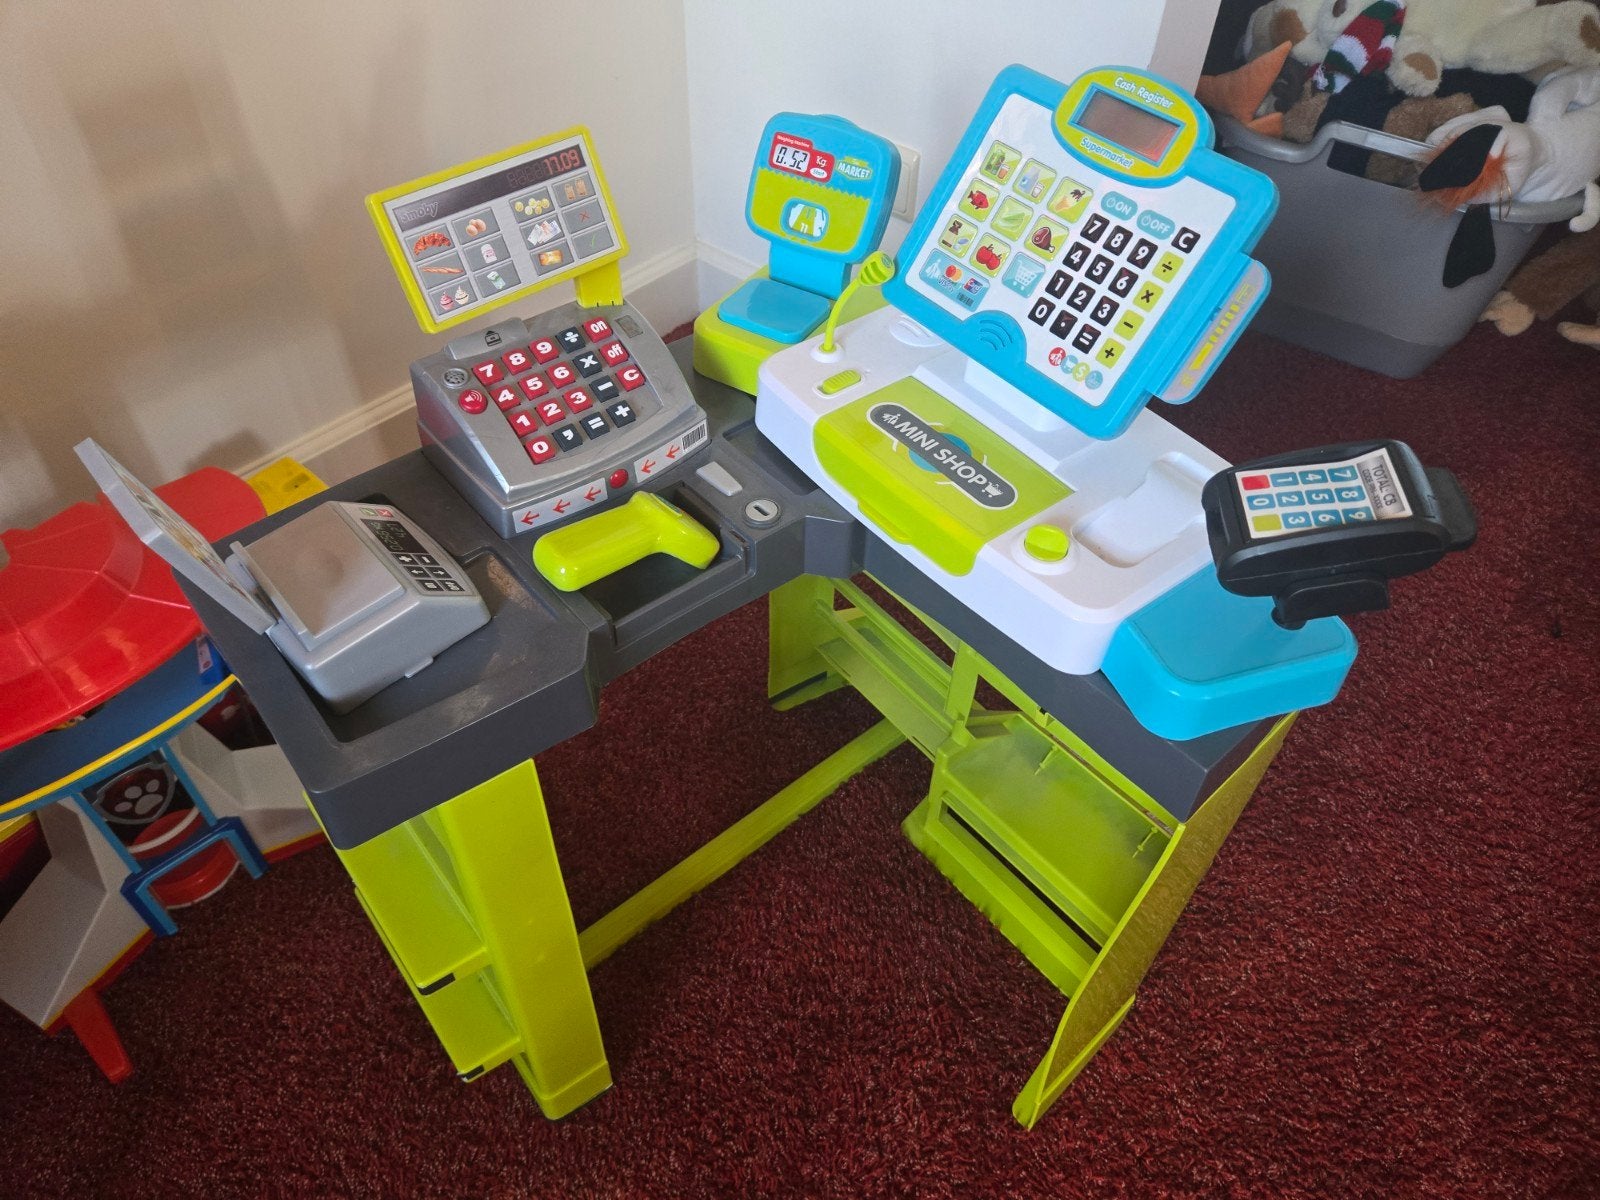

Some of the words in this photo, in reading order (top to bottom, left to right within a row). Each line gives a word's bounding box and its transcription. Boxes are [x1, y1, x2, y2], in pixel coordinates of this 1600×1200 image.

[1114, 77, 1136, 93] Cash
[1137, 87, 1174, 108] Register
[776, 147, 807, 169] 0.52
[1080, 137, 1133, 169] Supermarket
[544, 149, 581, 175] 17.09
[816, 156, 827, 167] Kg
[838, 162, 871, 178] MARKET
[400, 200, 439, 224] smoby
[1114, 201, 1132, 215] ON
[1087, 220, 1102, 234] 7
[1151, 218, 1171, 234] OFF
[1110, 233, 1124, 248] 8
[1178, 233, 1194, 248] C
[1070, 250, 1083, 264] 4
[1136, 245, 1149, 261] 9
[1092, 262, 1106, 276] 5
[1056, 277, 1065, 291] 1
[1116, 276, 1127, 290] 6
[1073, 291, 1087, 305] 2
[1035, 304, 1048, 318] 0
[1097, 303, 1111, 319] 3
[590, 320, 607, 333] on
[536, 341, 552, 354] 9
[607, 343, 624, 359] off
[509, 353, 526, 366] 8
[478, 363, 495, 378] 7
[553, 366, 570, 379] 6
[623, 369, 640, 382] C
[526, 377, 543, 391] 5
[498, 389, 515, 402] 4
[570, 391, 587, 404] 3
[544, 403, 562, 416] 2
[516, 415, 531, 426] 1
[531, 441, 549, 453] 0
[894, 421, 939, 451] MINI
[933, 448, 988, 487] SHOP
[1305, 473, 1322, 482] 4
[1334, 470, 1352, 478] 7
[1252, 497, 1270, 506] 0
[1281, 495, 1299, 504] 2
[1311, 493, 1329, 501] 5
[1341, 490, 1359, 499] 8
[1383, 493, 1397, 506] CB
[1288, 515, 1306, 525] 3
[1318, 513, 1336, 522] 6
[1348, 511, 1367, 520] 9
